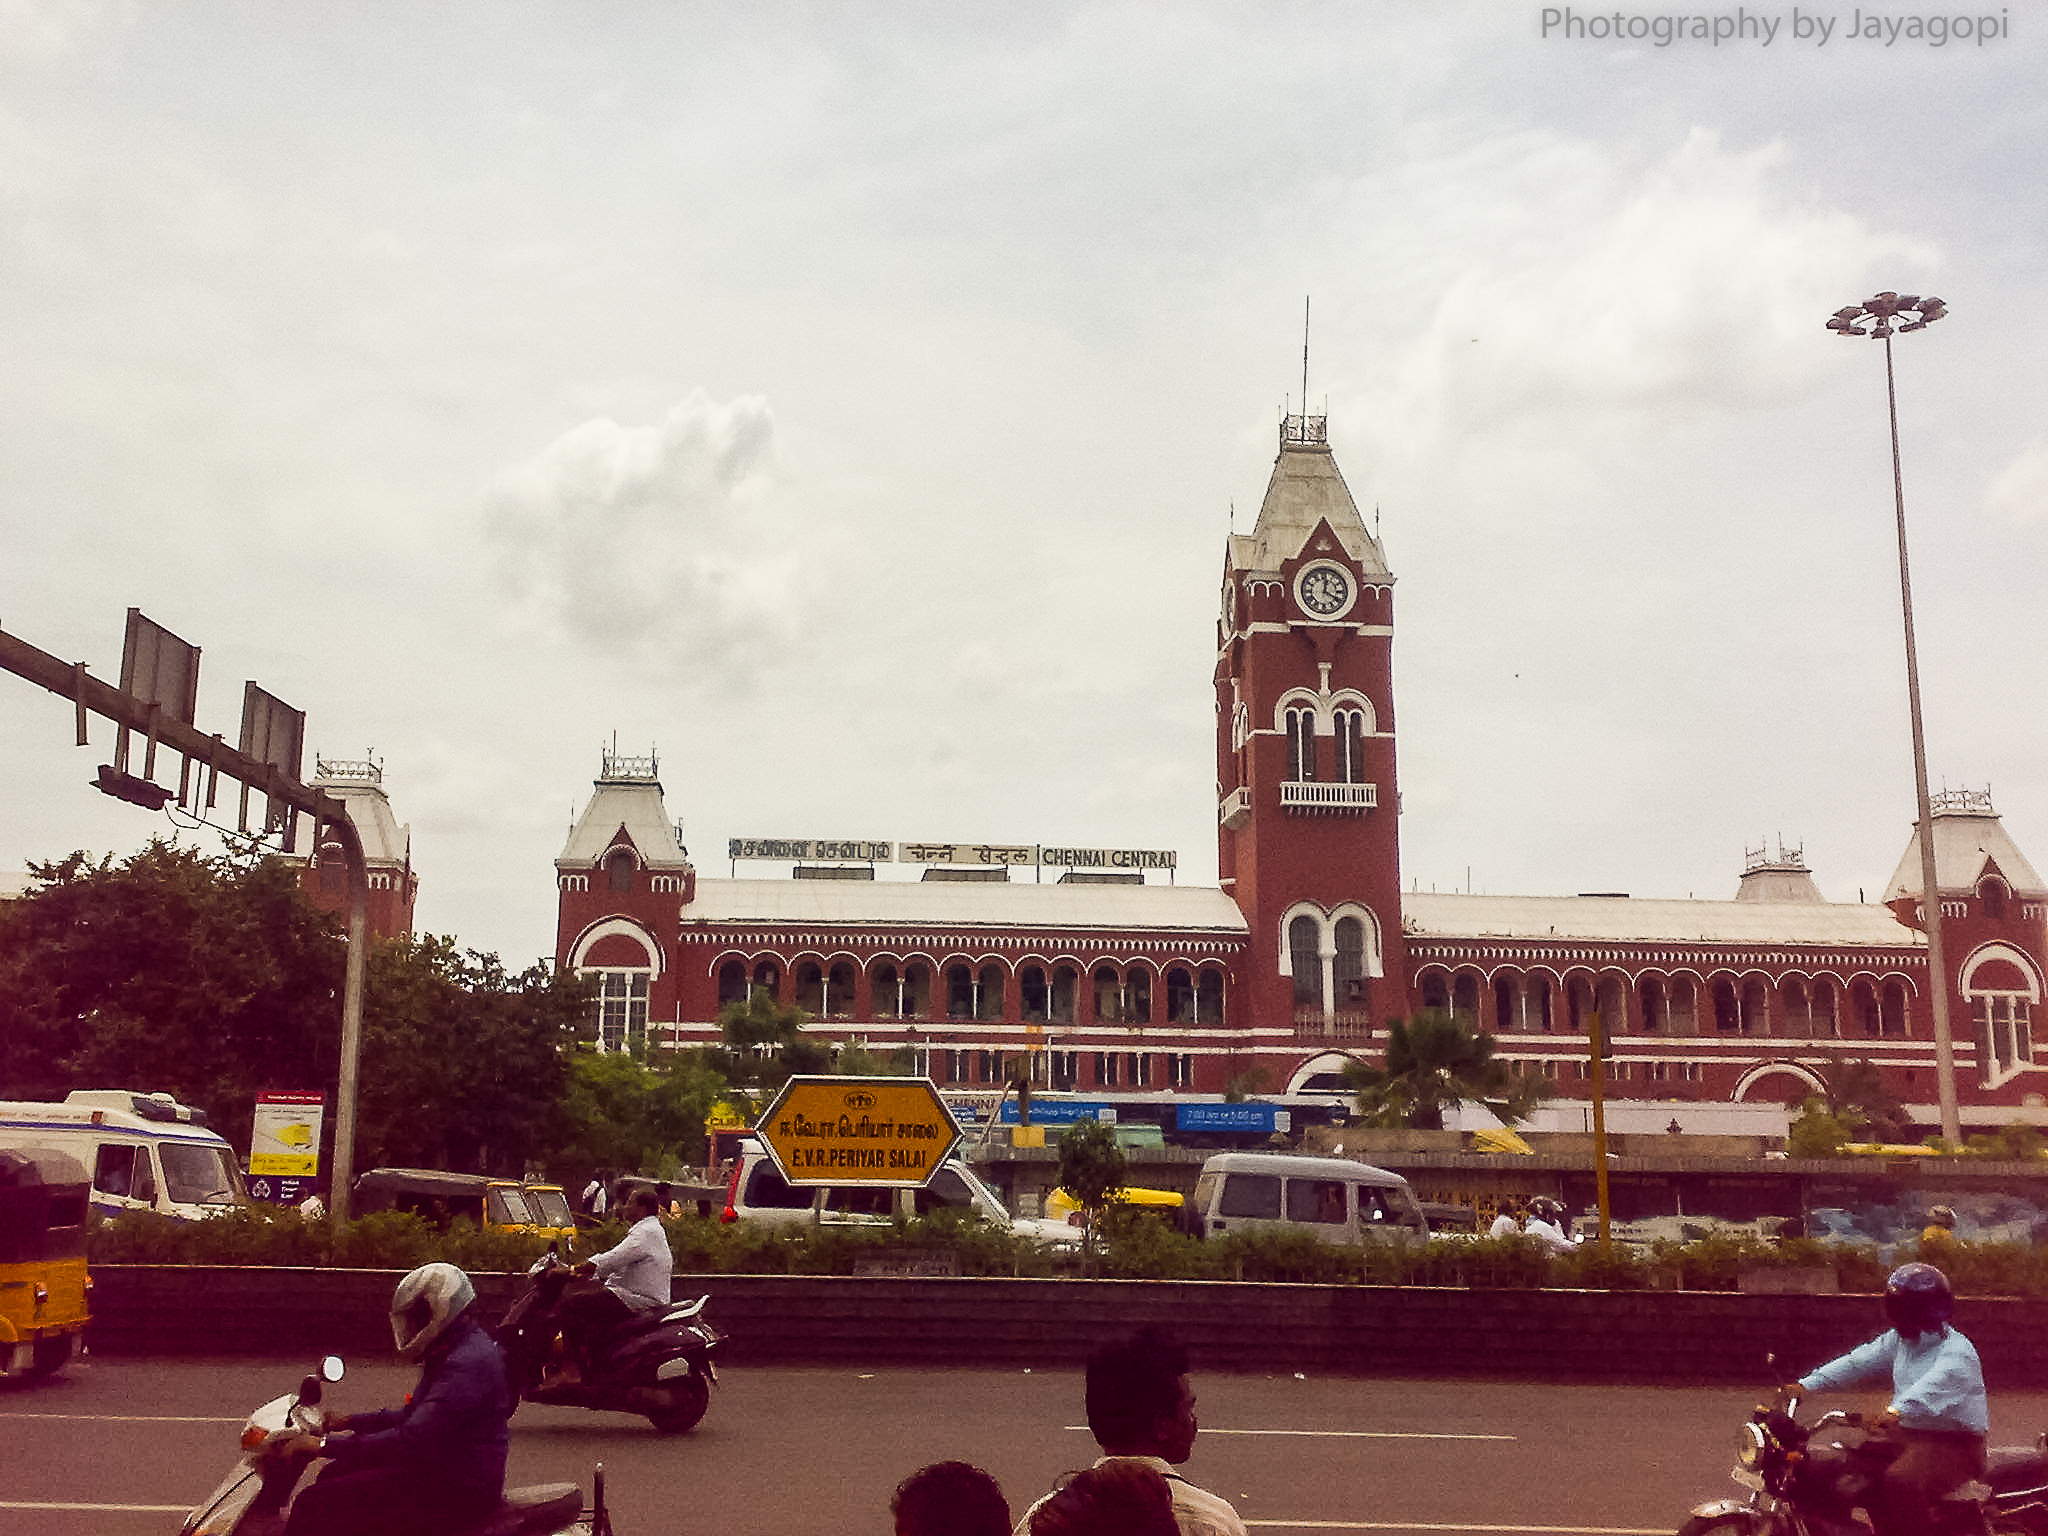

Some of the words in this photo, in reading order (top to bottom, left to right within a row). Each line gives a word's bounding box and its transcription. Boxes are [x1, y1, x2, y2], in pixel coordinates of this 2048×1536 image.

[1042, 847, 1106, 868] CHENNAI
[1112, 849, 1177, 870] CENTRAL
[889, 1148, 927, 1169] SALAI
